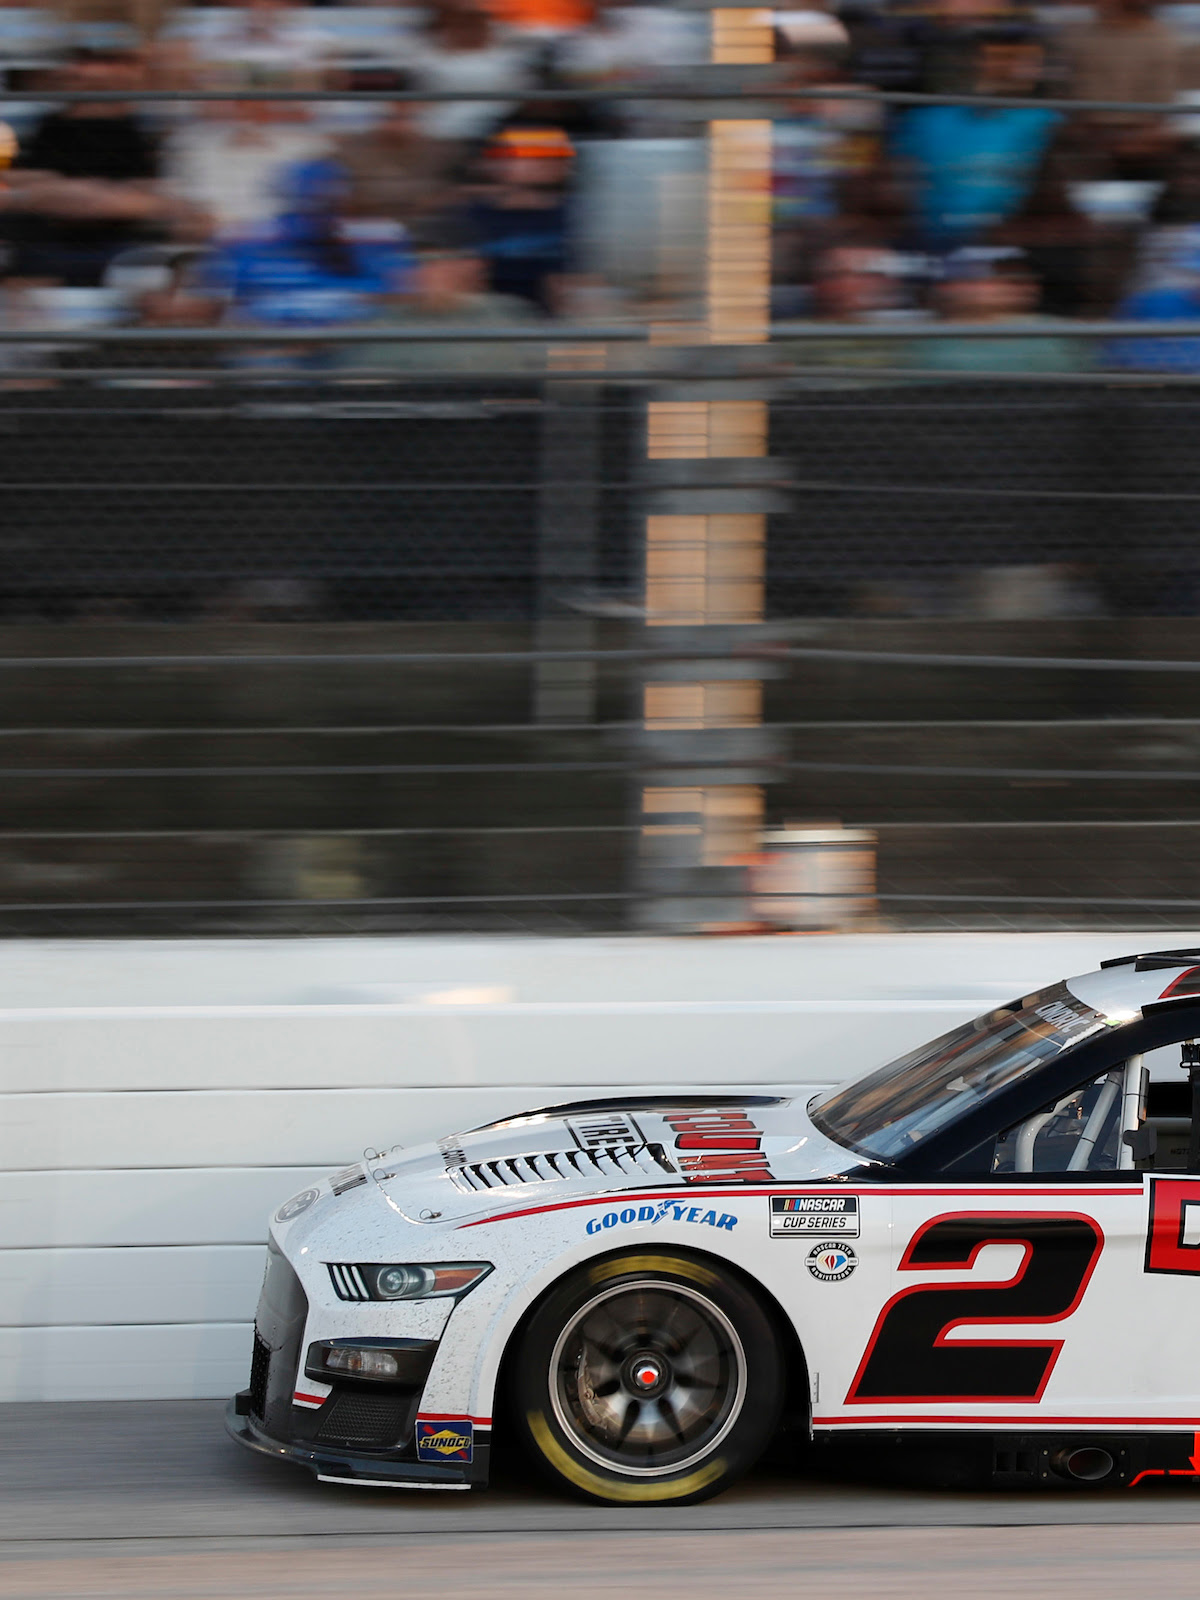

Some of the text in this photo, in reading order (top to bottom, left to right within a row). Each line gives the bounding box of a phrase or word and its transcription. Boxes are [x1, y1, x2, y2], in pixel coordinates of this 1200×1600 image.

[575, 1115, 636, 1147] TIRE
[650, 1109, 777, 1184] COUNT
[799, 1198, 846, 1211] NASCAR
[586, 1202, 739, 1236] GOODYEAR
[783, 1216, 847, 1228] CUP SERIES
[812, 1243, 837, 1256] NASCAR
[811, 1266, 853, 1281] ANNIVERSARY
[843, 1210, 1105, 1405] 2
[421, 1437, 471, 1448] SUNOCO
